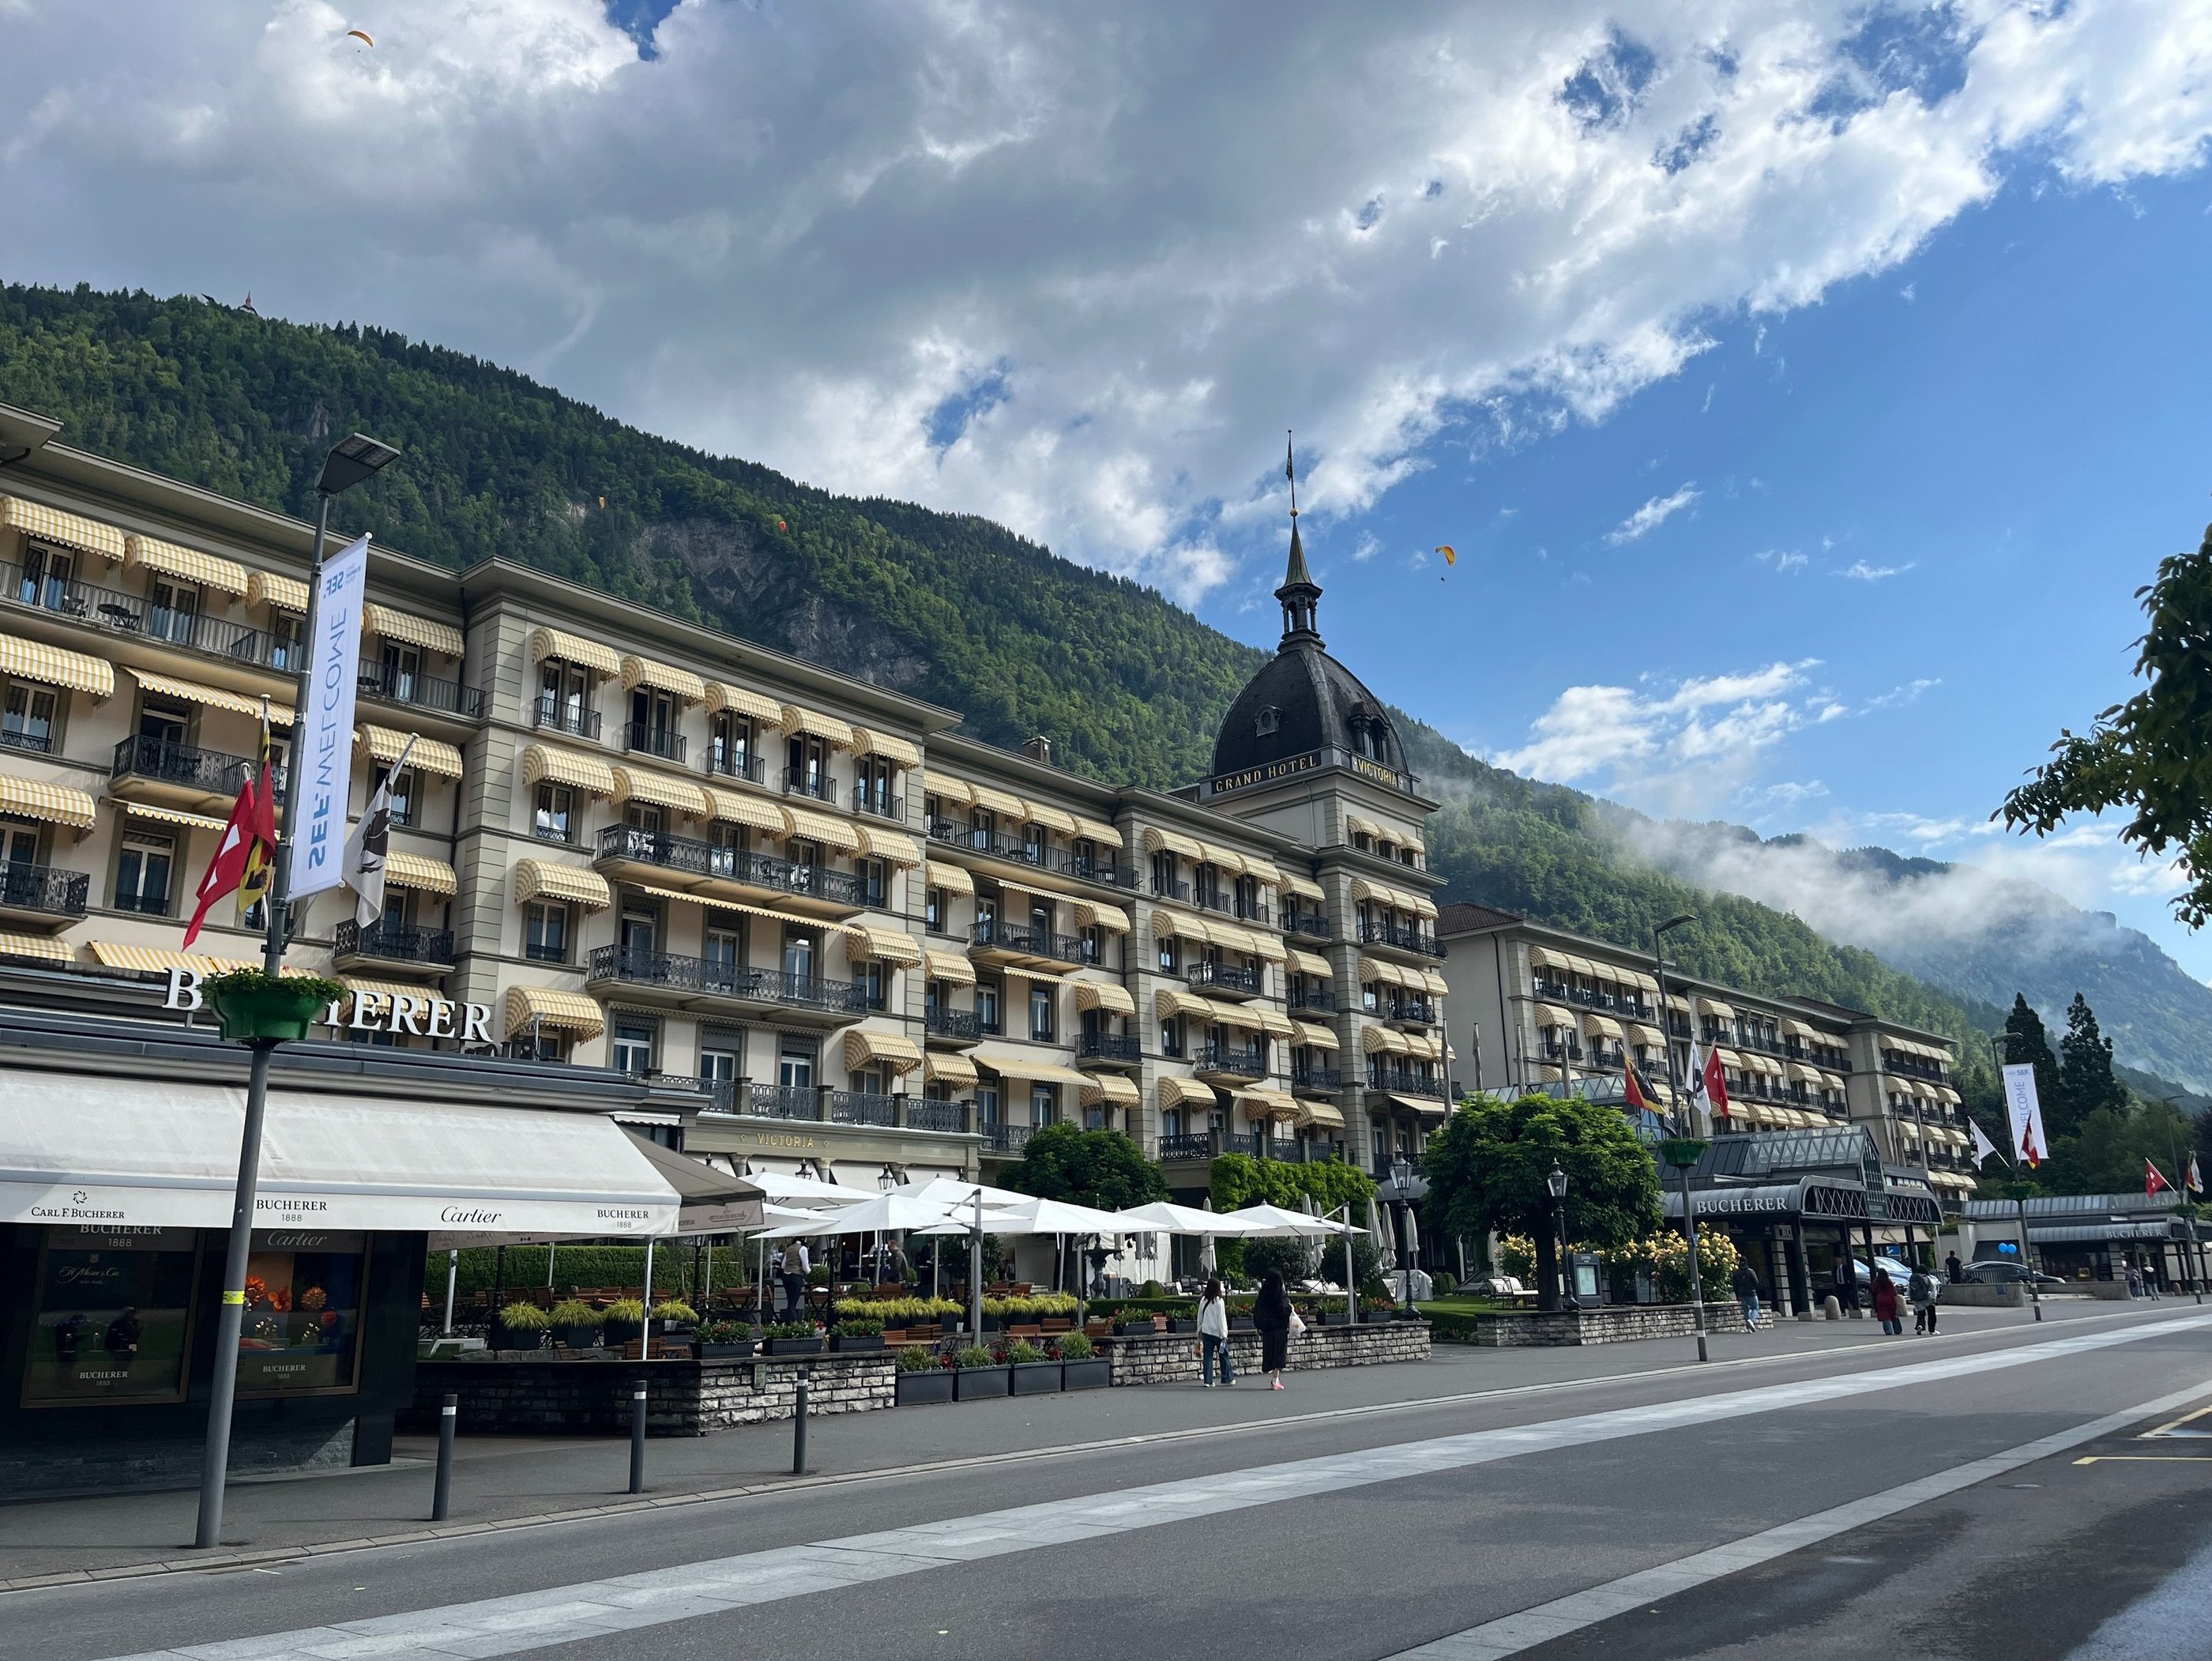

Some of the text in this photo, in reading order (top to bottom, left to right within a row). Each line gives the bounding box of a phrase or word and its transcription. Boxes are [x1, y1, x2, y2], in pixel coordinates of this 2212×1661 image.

[1216, 755, 1317, 792] GRAND HOTEL
[1357, 757, 1398, 787] VICTORIA
[161, 966, 494, 1042] BERER
[757, 1132, 814, 1148] VICTORIA
[31, 1207, 60, 1217] CARL
[72, 1208, 125, 1219] BUCHERER
[257, 1200, 327, 1211] BUCHERER
[1696, 1197, 1788, 1214] BUCHERER
[441, 1206, 502, 1223] Cartier
[597, 1209, 649, 1219] BUCHERER
[80, 1225, 163, 1235] BUCHERER
[267, 1230, 327, 1246] Cartier
[2106, 1229, 2163, 1238] BUCHERER
[107, 1238, 133, 1247] 1888
